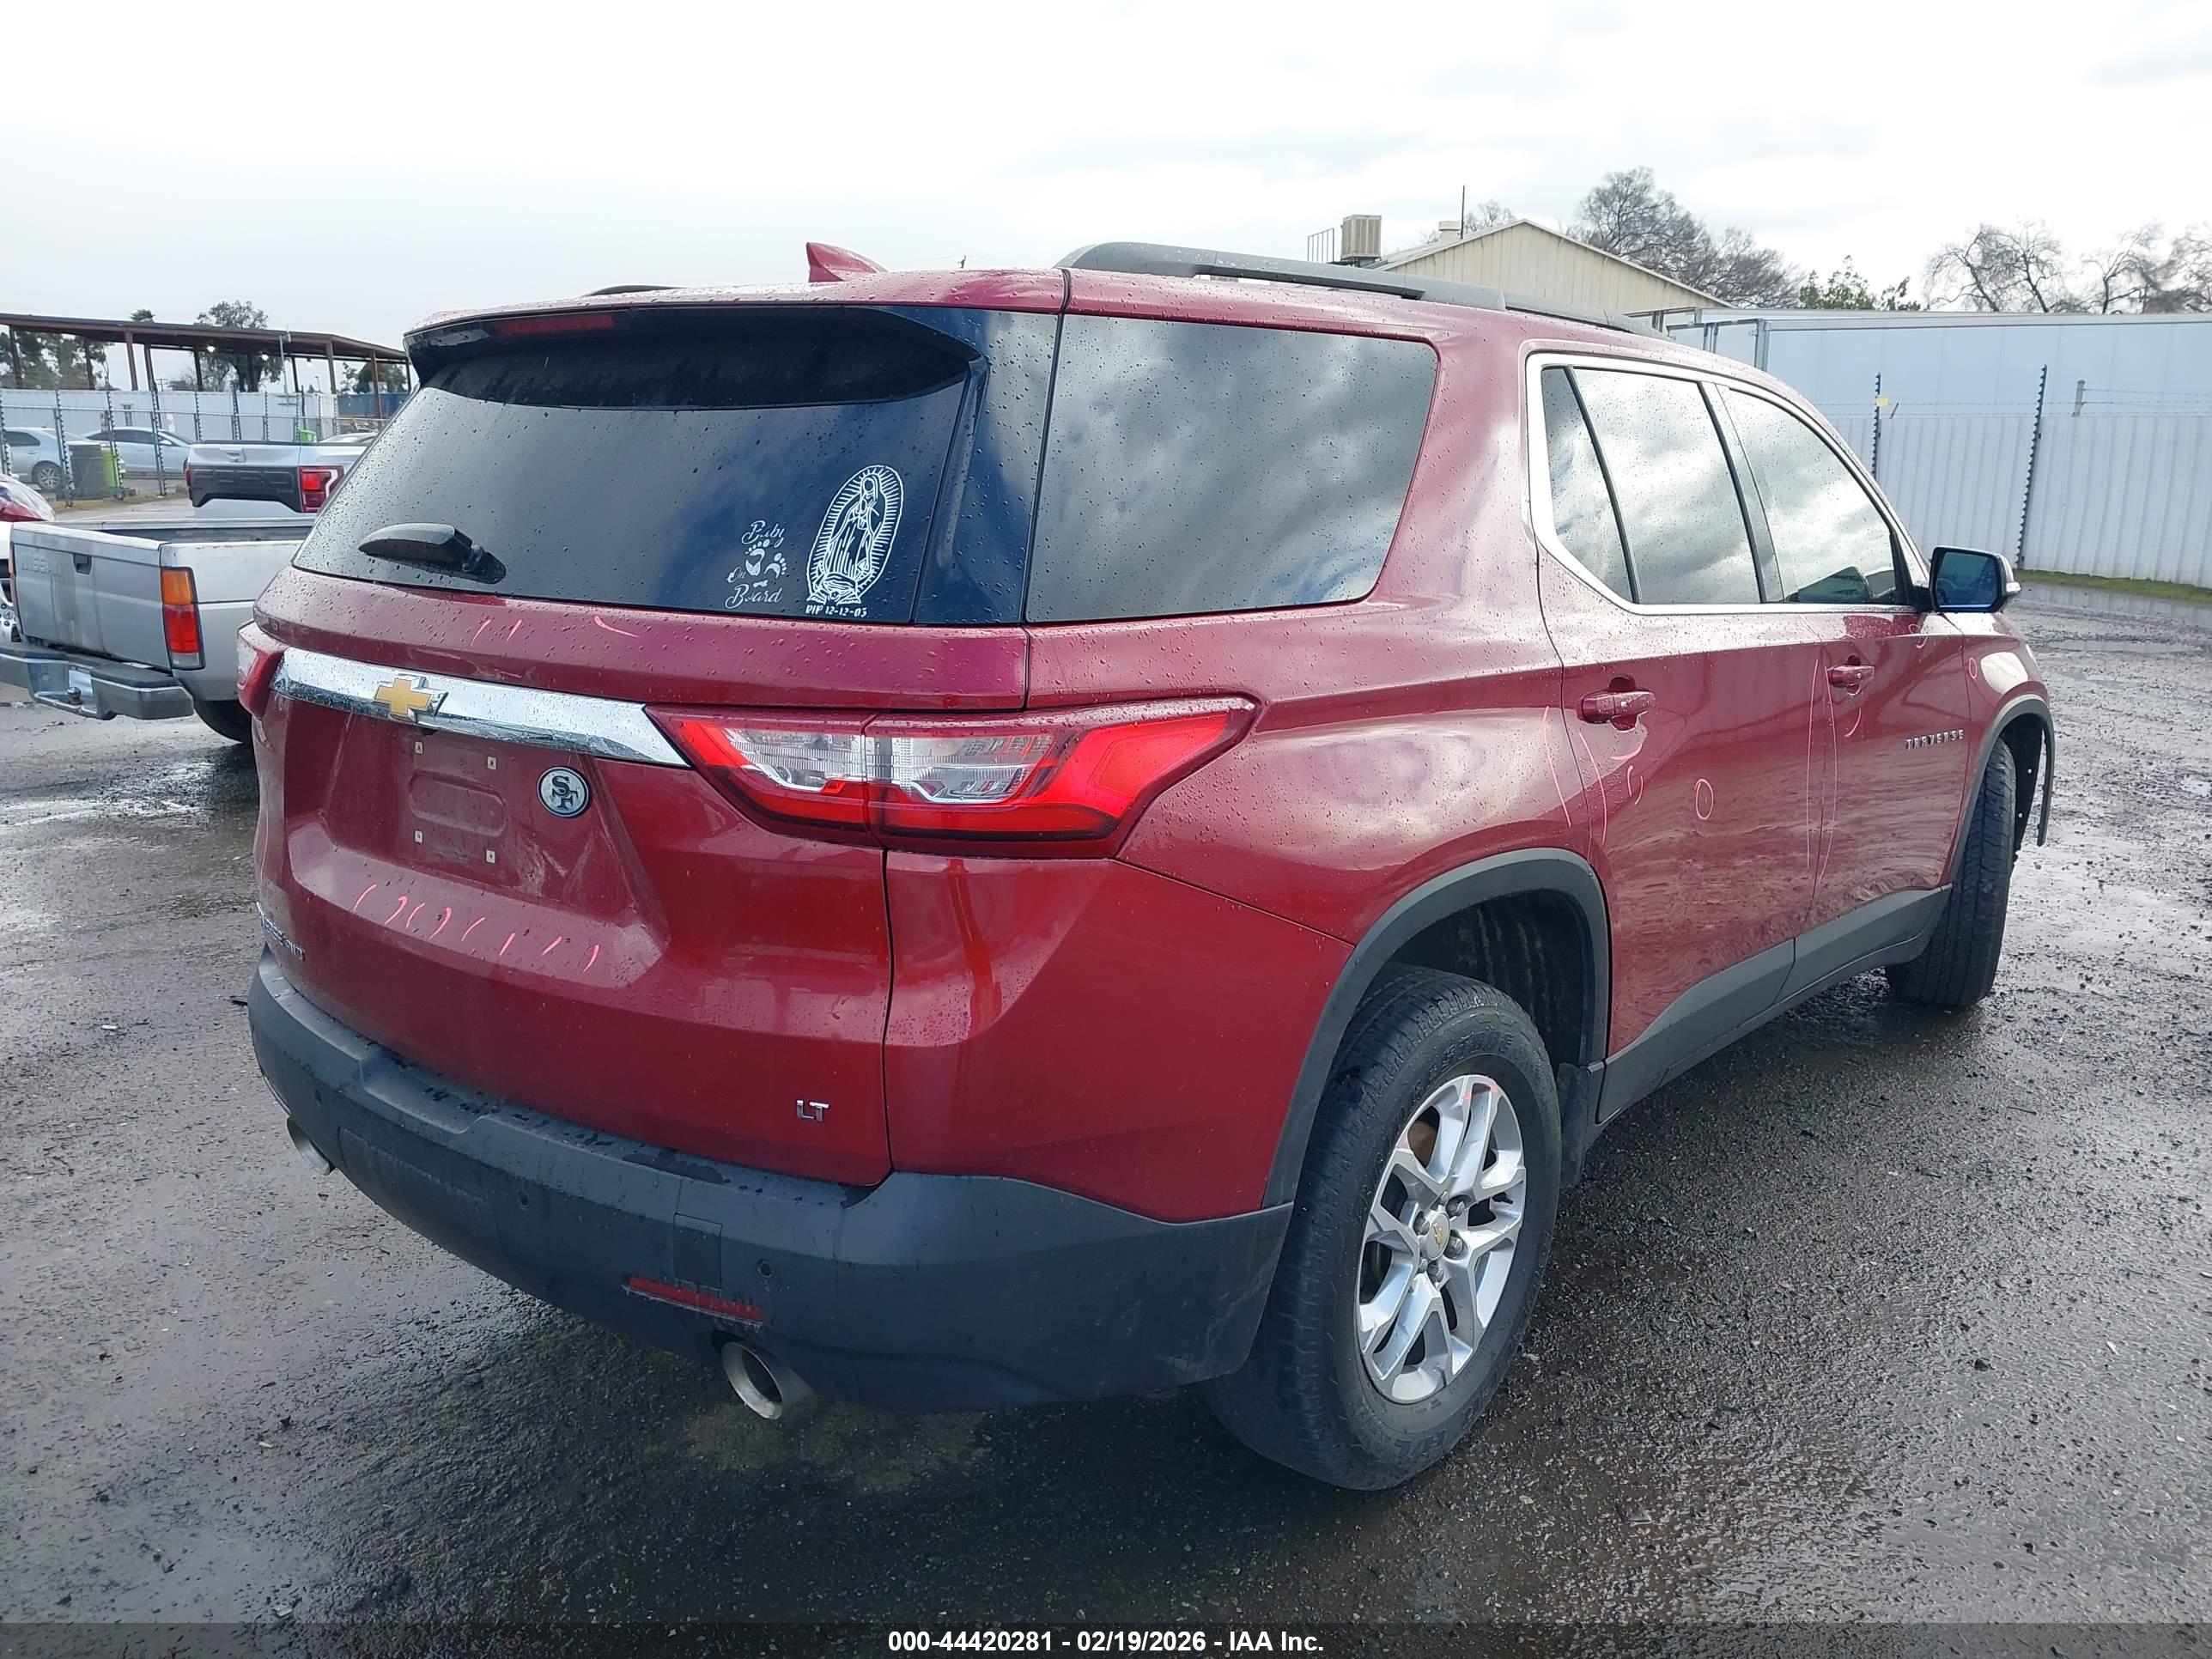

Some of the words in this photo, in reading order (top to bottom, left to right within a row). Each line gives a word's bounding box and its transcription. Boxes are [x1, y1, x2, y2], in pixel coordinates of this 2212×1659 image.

[805, 605, 824, 616] RIP
[1905, 730, 1965, 750] TRAVERSE
[797, 1099, 830, 1121] LT
